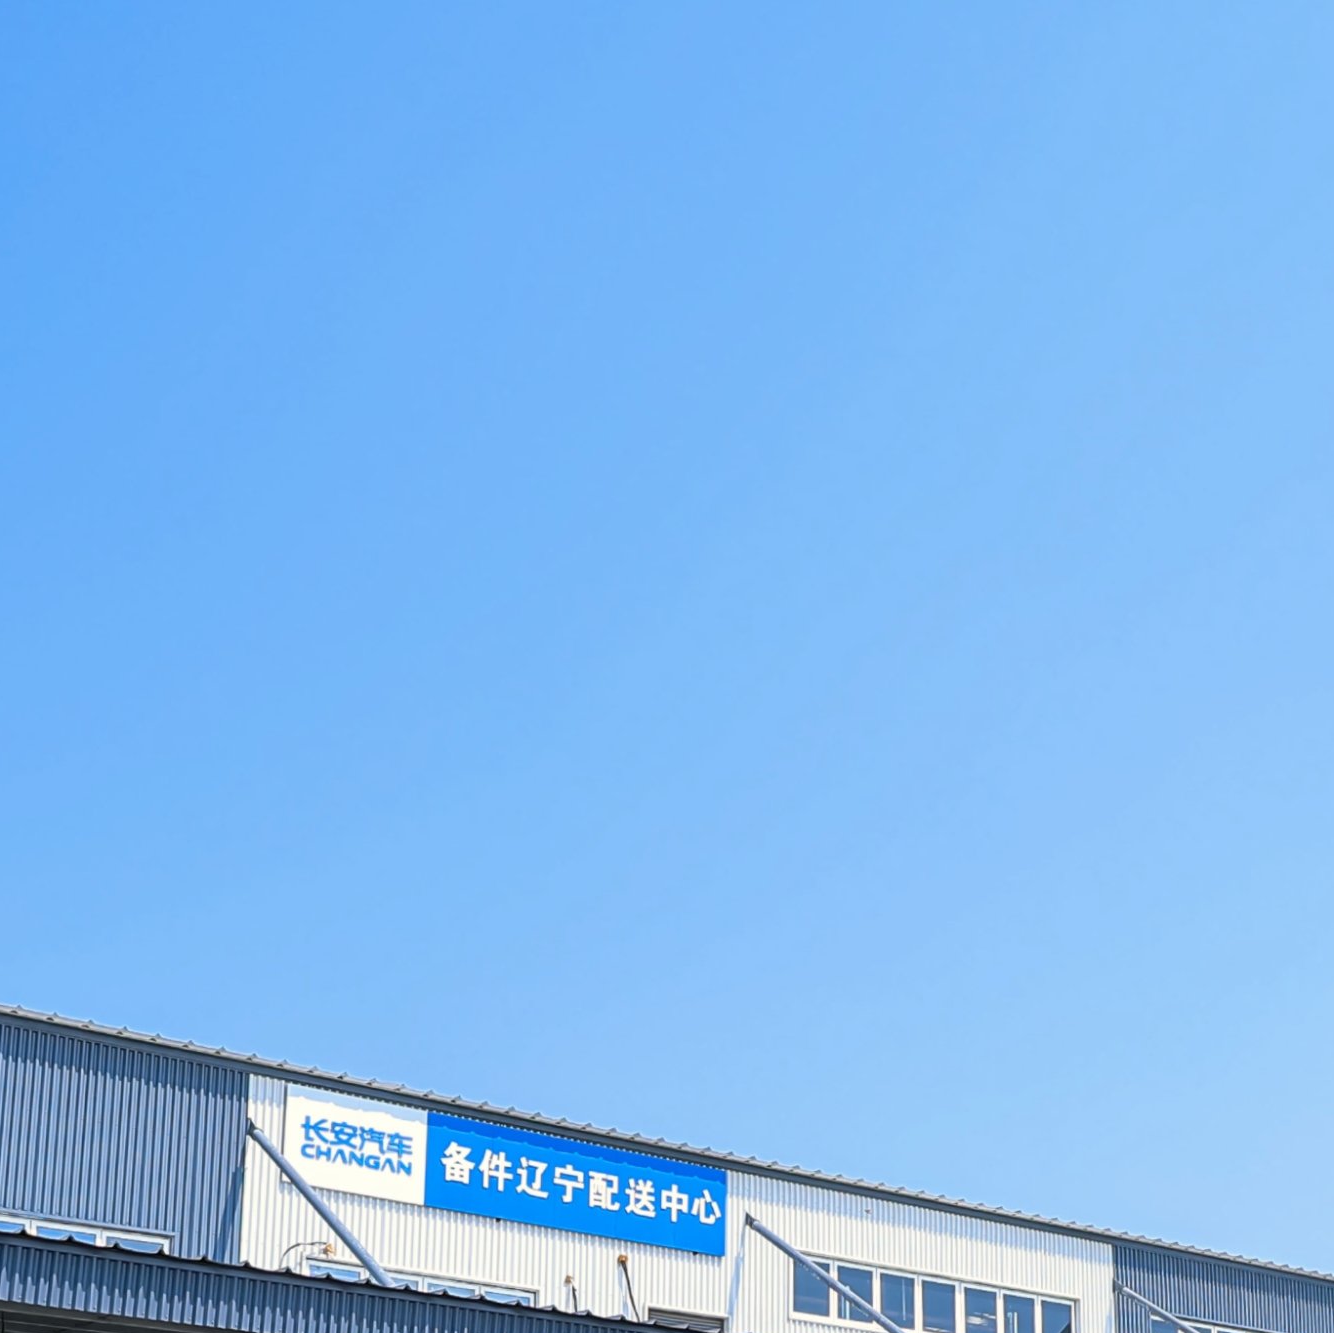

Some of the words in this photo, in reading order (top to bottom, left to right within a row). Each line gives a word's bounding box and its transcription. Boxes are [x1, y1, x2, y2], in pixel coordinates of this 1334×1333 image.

[301, 1115, 413, 1158] 长安汽车
[300, 1143, 413, 1176] CHANGAN
[441, 1141, 722, 1225] 备件辽宁配送中心
